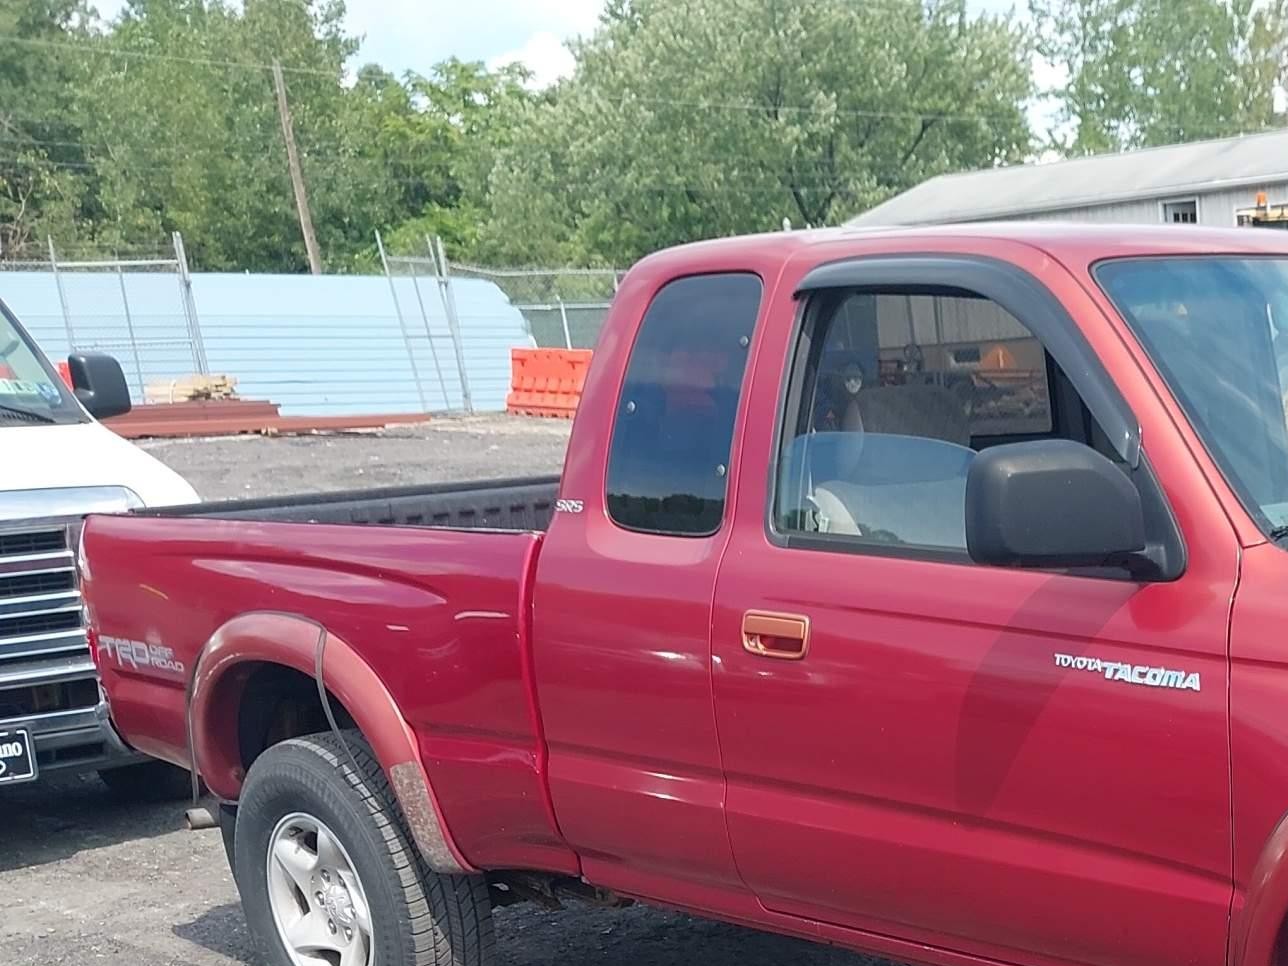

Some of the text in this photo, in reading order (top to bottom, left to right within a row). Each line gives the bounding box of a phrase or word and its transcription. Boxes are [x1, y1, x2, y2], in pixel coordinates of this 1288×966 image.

[98, 634, 150, 669] TRD
[148, 643, 173, 658] OFF
[151, 657, 184, 673] ROAD
[1054, 653, 1201, 691] TOYOTA TACOMA
